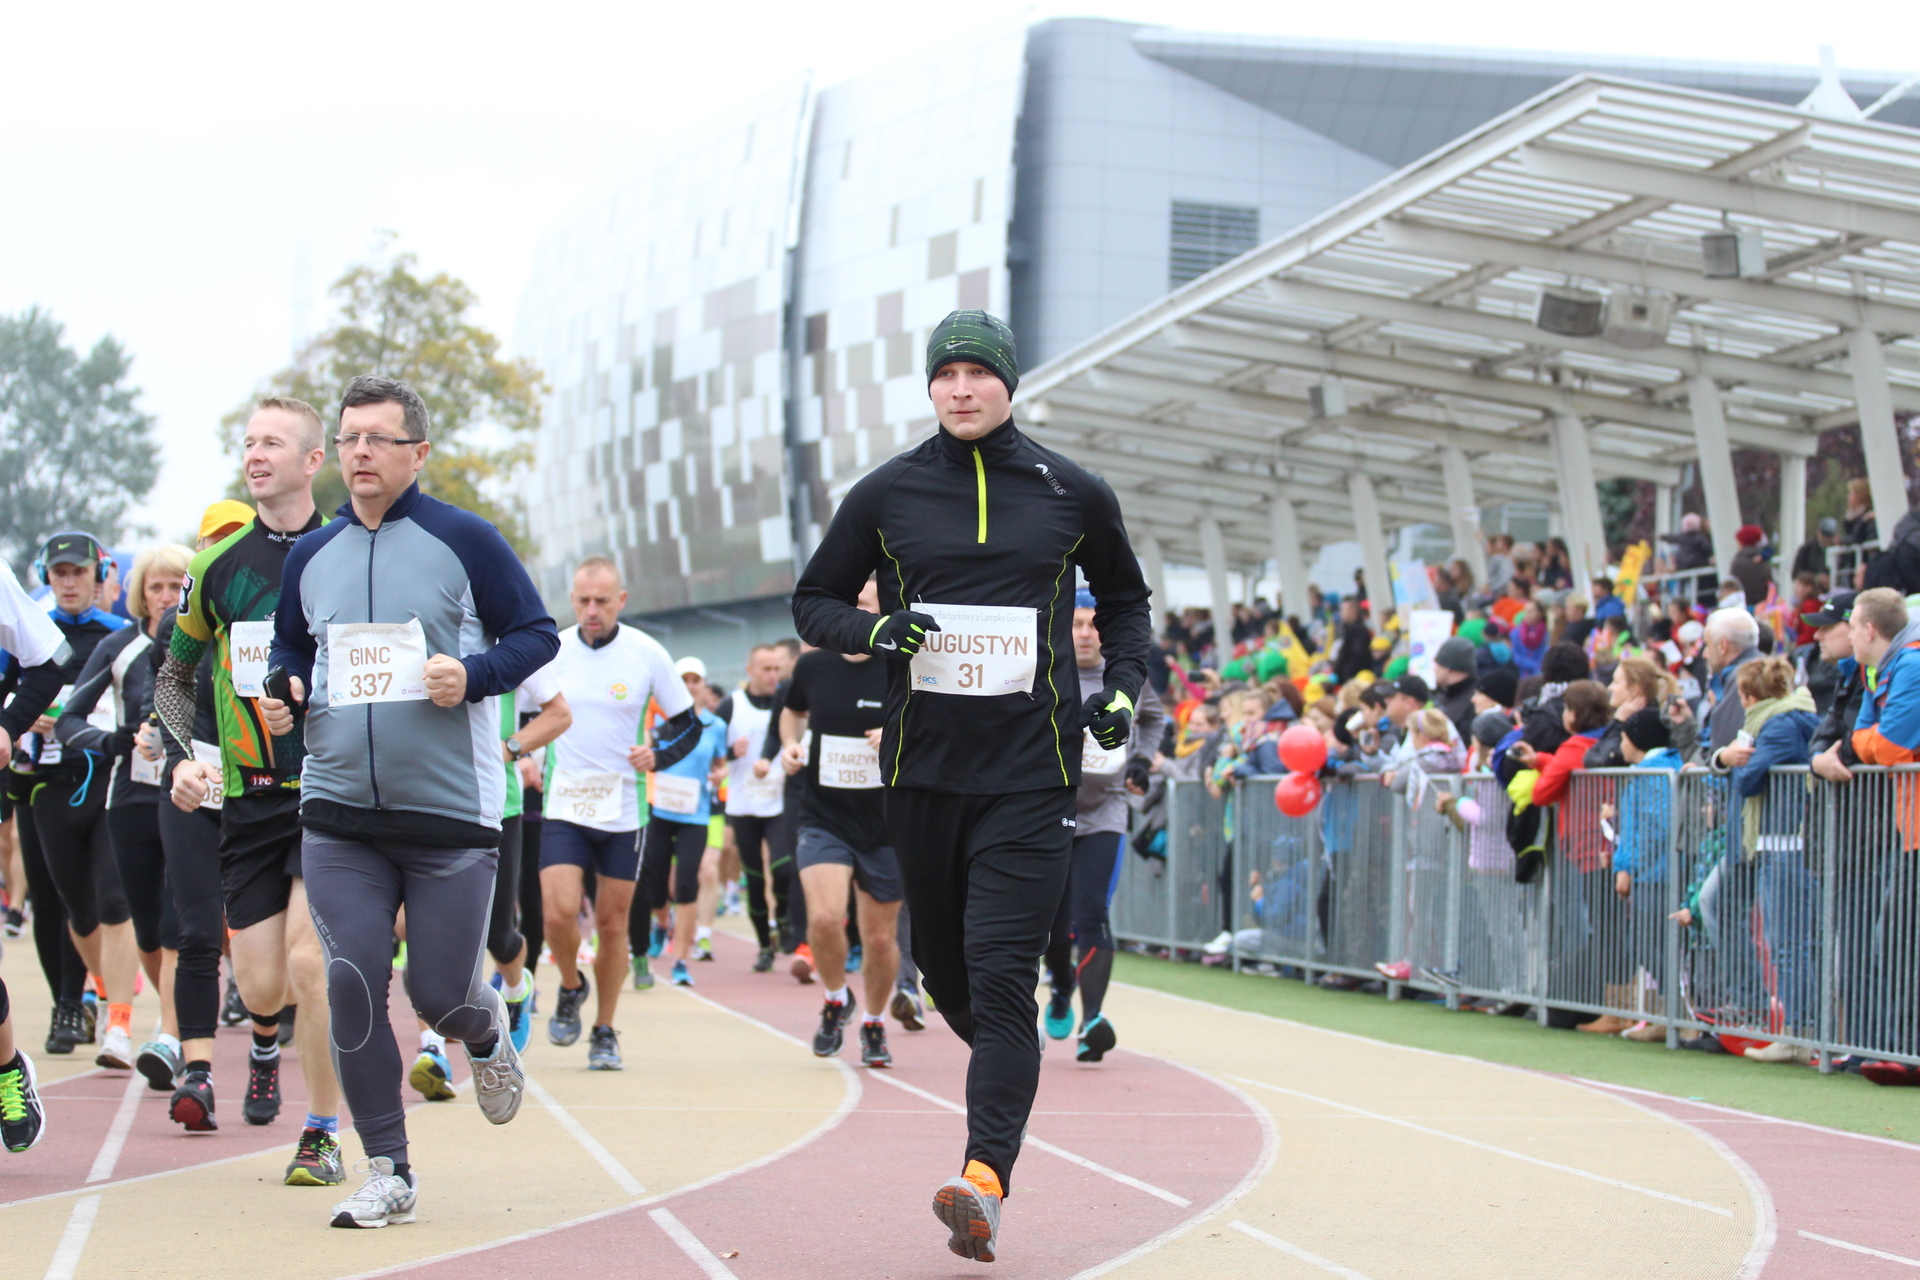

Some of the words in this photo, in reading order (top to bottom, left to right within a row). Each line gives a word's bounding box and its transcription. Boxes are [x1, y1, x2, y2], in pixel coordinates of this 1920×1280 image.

[350, 646, 391, 667] GINC
[350, 672, 393, 698] 337
[958, 663, 983, 689] 31
[838, 769, 867, 784] 1315
[572, 803, 597, 818] 175
